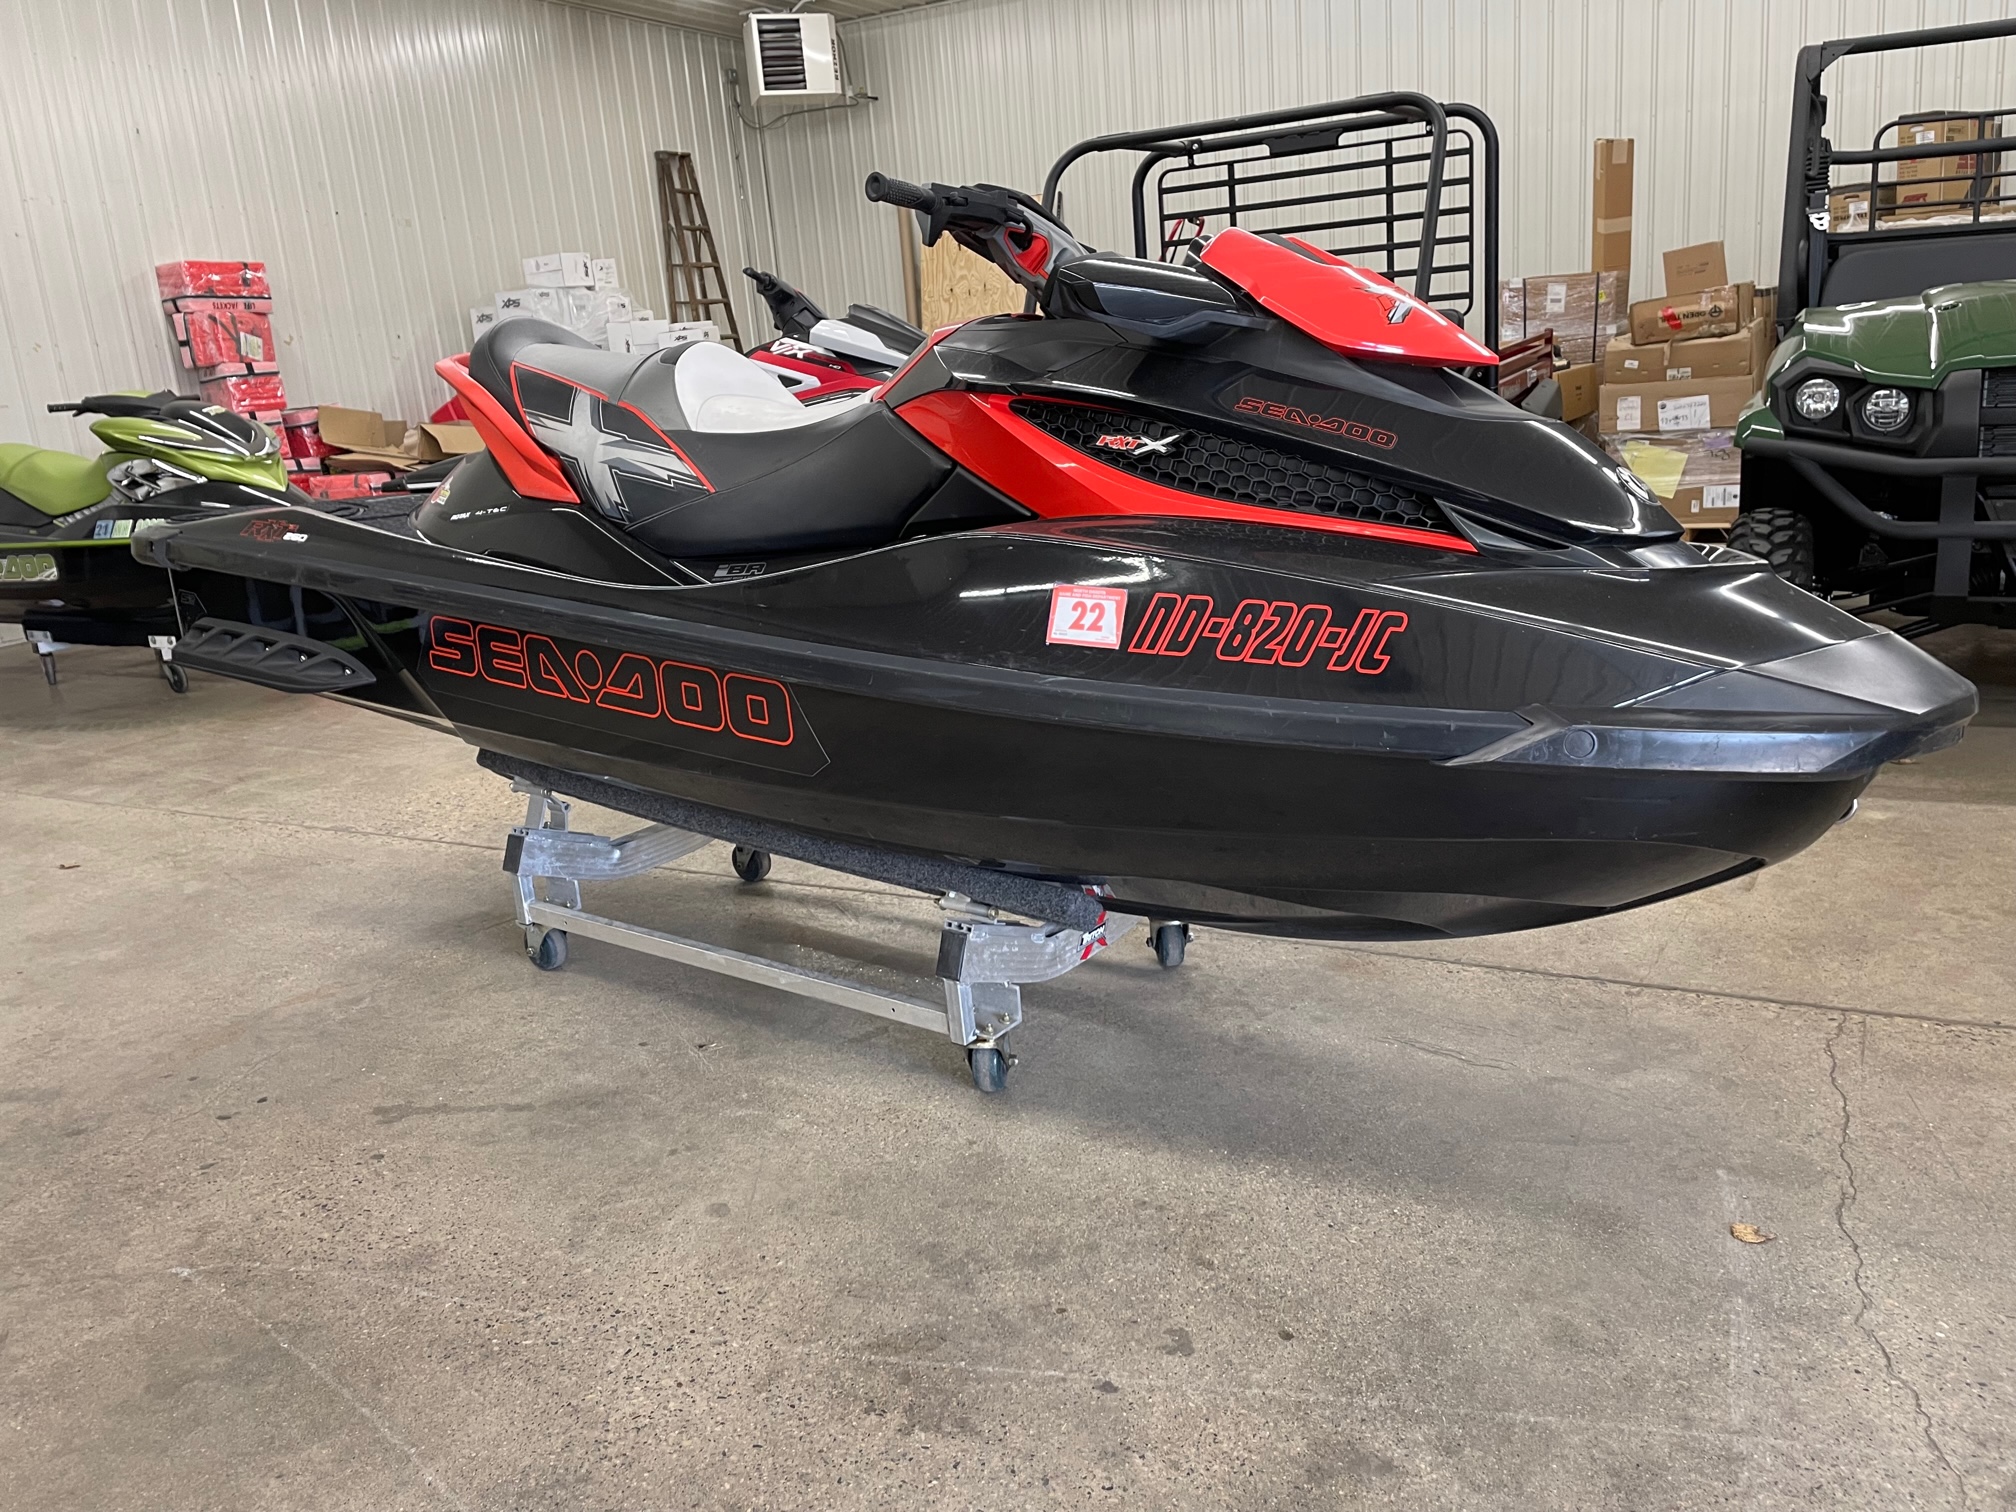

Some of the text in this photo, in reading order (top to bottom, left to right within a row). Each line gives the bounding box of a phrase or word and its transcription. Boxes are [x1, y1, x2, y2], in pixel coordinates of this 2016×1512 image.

[830, 38, 839, 81] REZNOR
[212, 301, 238, 310] JACKETS
[501, 298, 520, 309] XPS
[476, 313, 493, 324] XPS
[1682, 310, 1707, 320] OPEN
[95, 523, 110, 537] 21
[1068, 601, 1106, 633] 22
[1128, 592, 1408, 675] ND-820-JC
